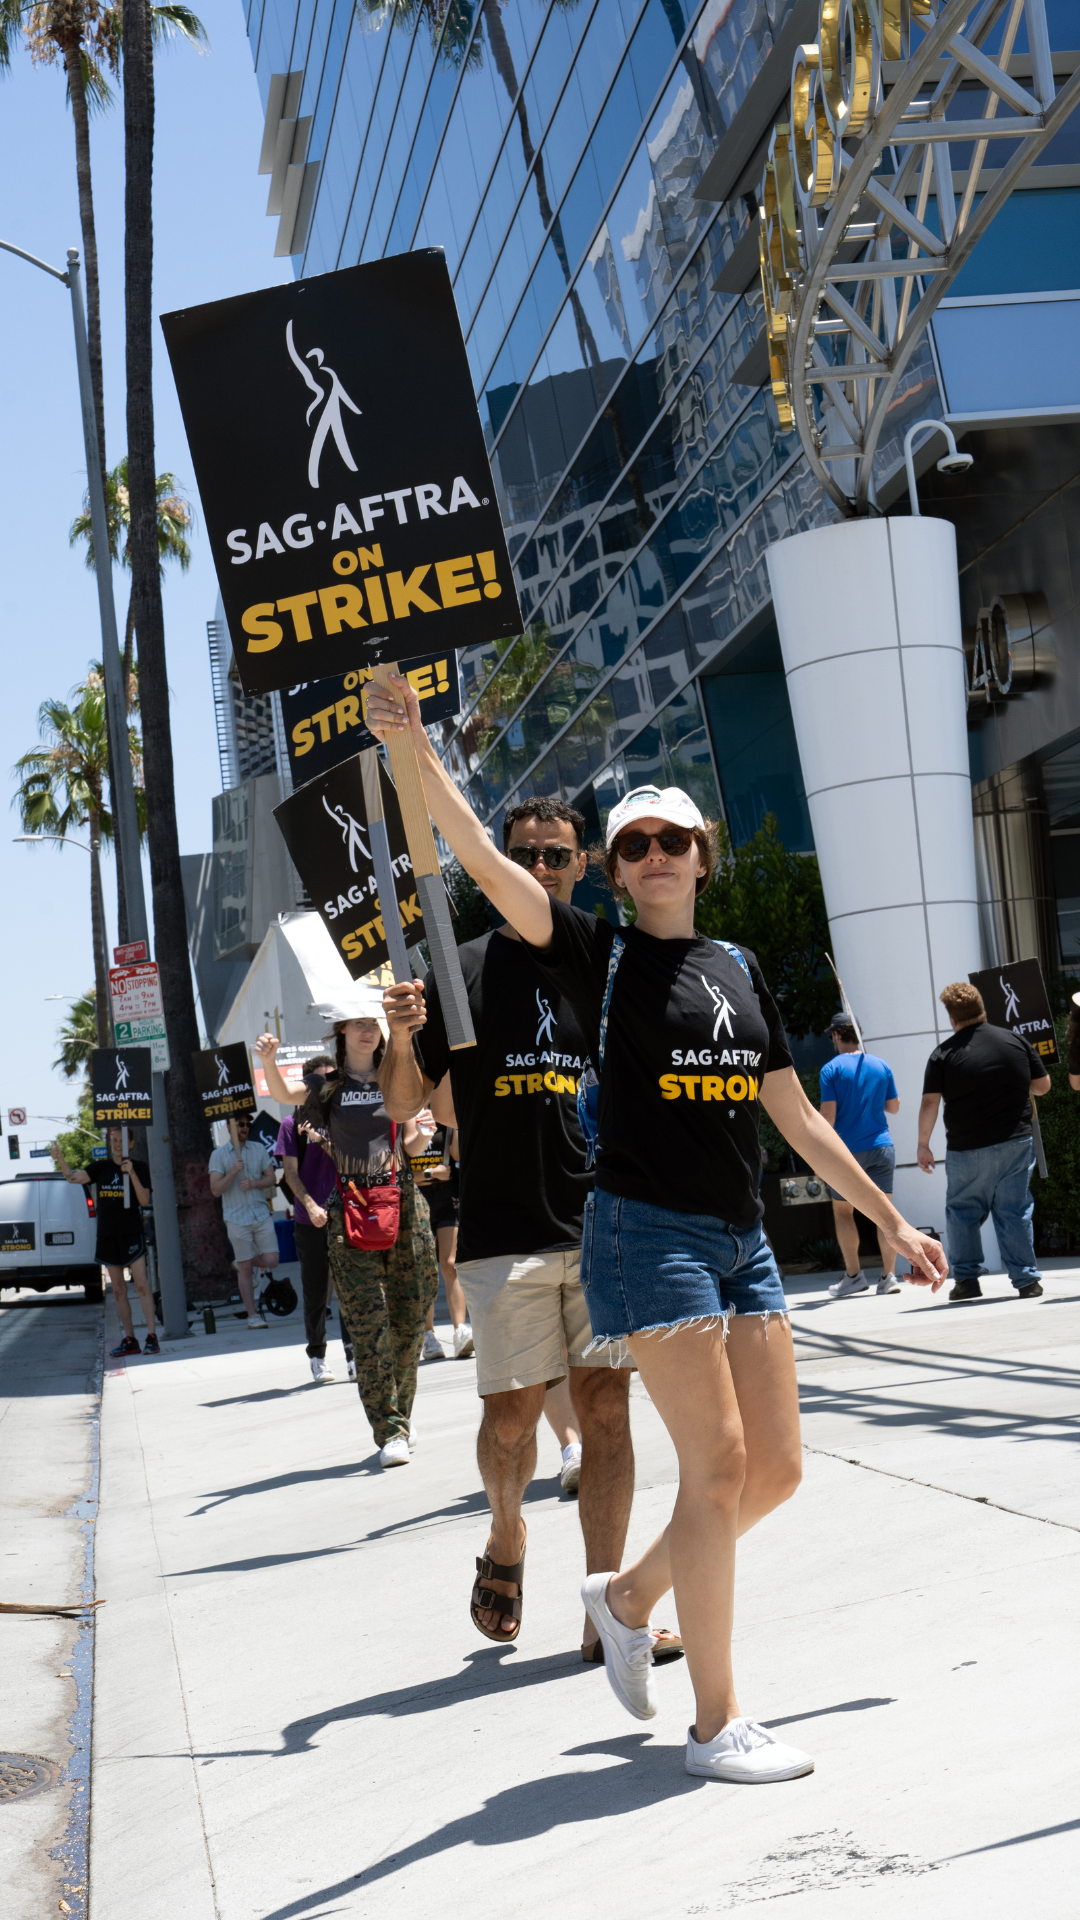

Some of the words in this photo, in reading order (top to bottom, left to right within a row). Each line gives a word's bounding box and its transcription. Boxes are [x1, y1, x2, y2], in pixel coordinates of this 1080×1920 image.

[332, 543, 384, 576] ON
[241, 550, 502, 653] STRIKE!
[343, 667, 374, 691] ON
[292, 658, 450, 757] STRIE!
[110, 979, 126, 995] NO
[127, 976, 158, 990] STOPPING
[141, 991, 155, 999] 9AM
[142, 1000, 156, 1008] 7PM
[119, 1024, 129, 1038] 2
[133, 1024, 163, 1037] PARKING
[1012, 1018, 1050, 1035] AFTRA
[276, 1045, 297, 1053] TERS
[494, 1071, 581, 1097] STRON
[658, 1073, 759, 1101] STRON
[96, 1108, 151, 1120] STRIKE!
[204, 1096, 254, 1117] STRIKE!
[410, 1156, 444, 1164] SUPPORT
